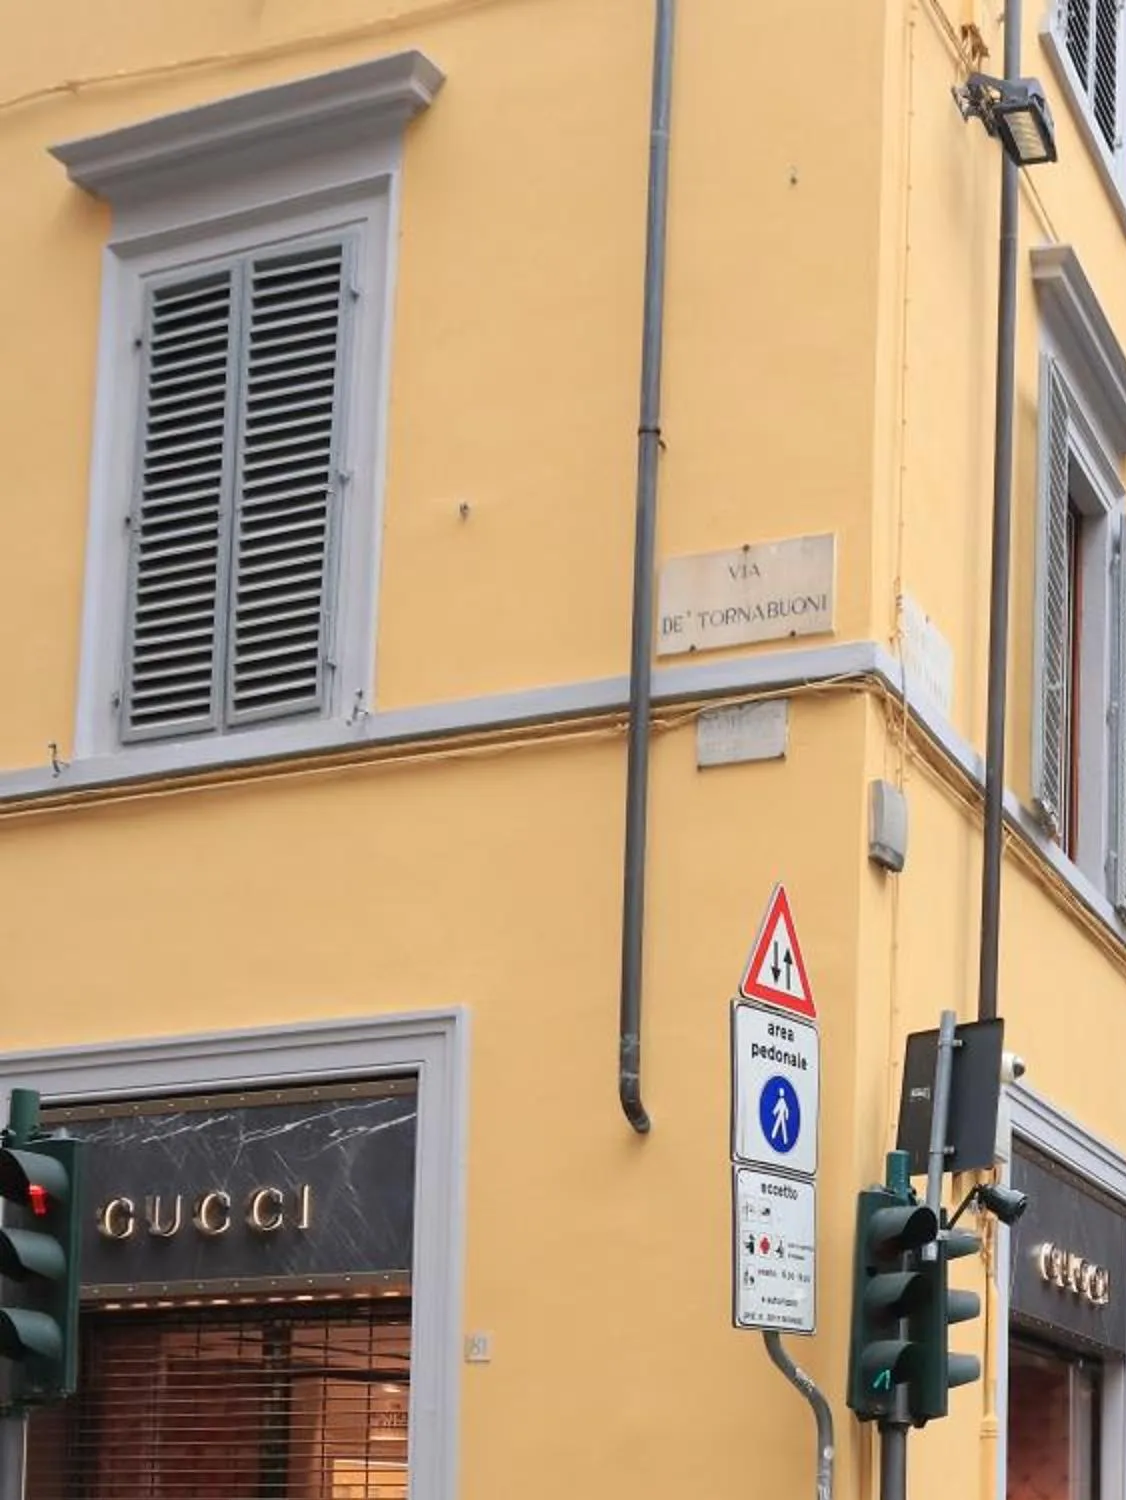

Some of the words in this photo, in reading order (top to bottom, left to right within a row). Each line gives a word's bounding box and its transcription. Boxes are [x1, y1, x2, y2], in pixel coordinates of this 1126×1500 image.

[728, 562, 761, 580] VIA
[699, 593, 828, 629] TORNABUONI
[767, 1022, 795, 1042] area
[751, 1042, 807, 1071] pedonale
[761, 1182, 799, 1201] eccetto
[98, 1184, 310, 1239] GUCCI
